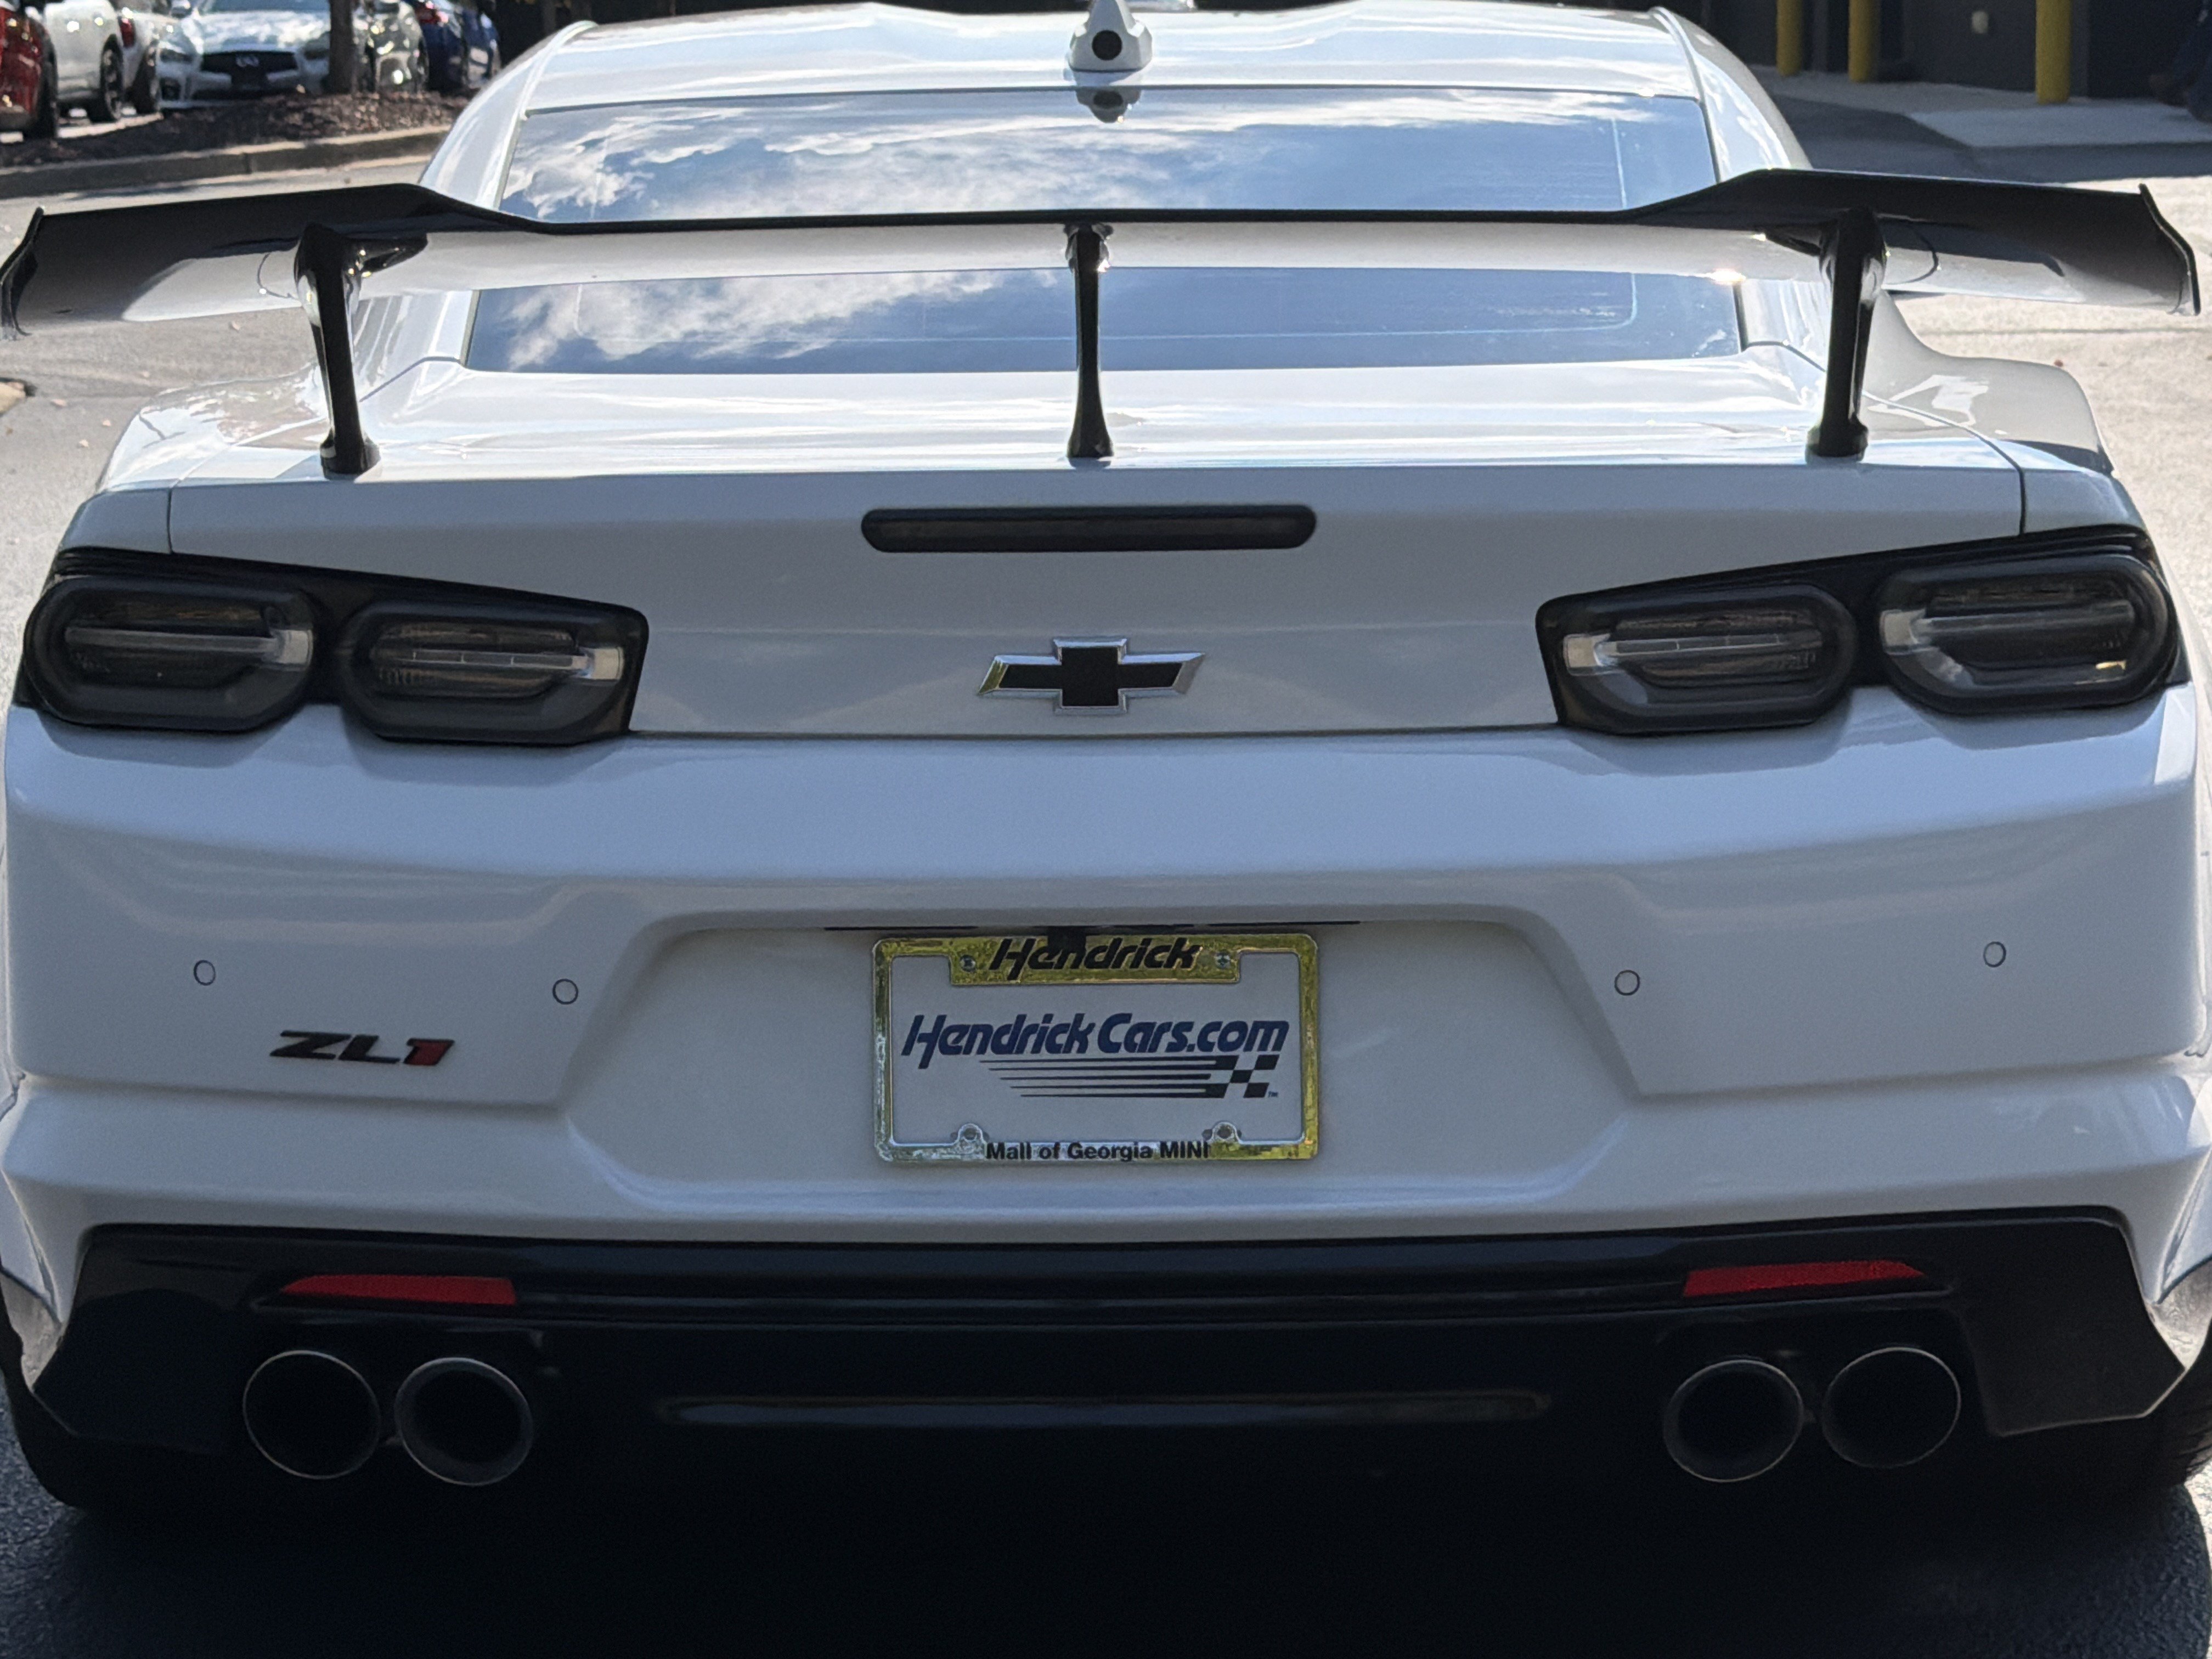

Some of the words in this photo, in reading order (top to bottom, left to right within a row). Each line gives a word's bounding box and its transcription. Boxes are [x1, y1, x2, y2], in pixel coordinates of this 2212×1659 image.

[989, 937, 1198, 980] Hendrick
[269, 1030, 455, 1065] ZL1
[986, 1142, 1031, 1160] Mall
[1039, 1142, 1062, 1159] of
[1067, 1142, 1154, 1163] Georgia
[1160, 1142, 1210, 1159] MINI
